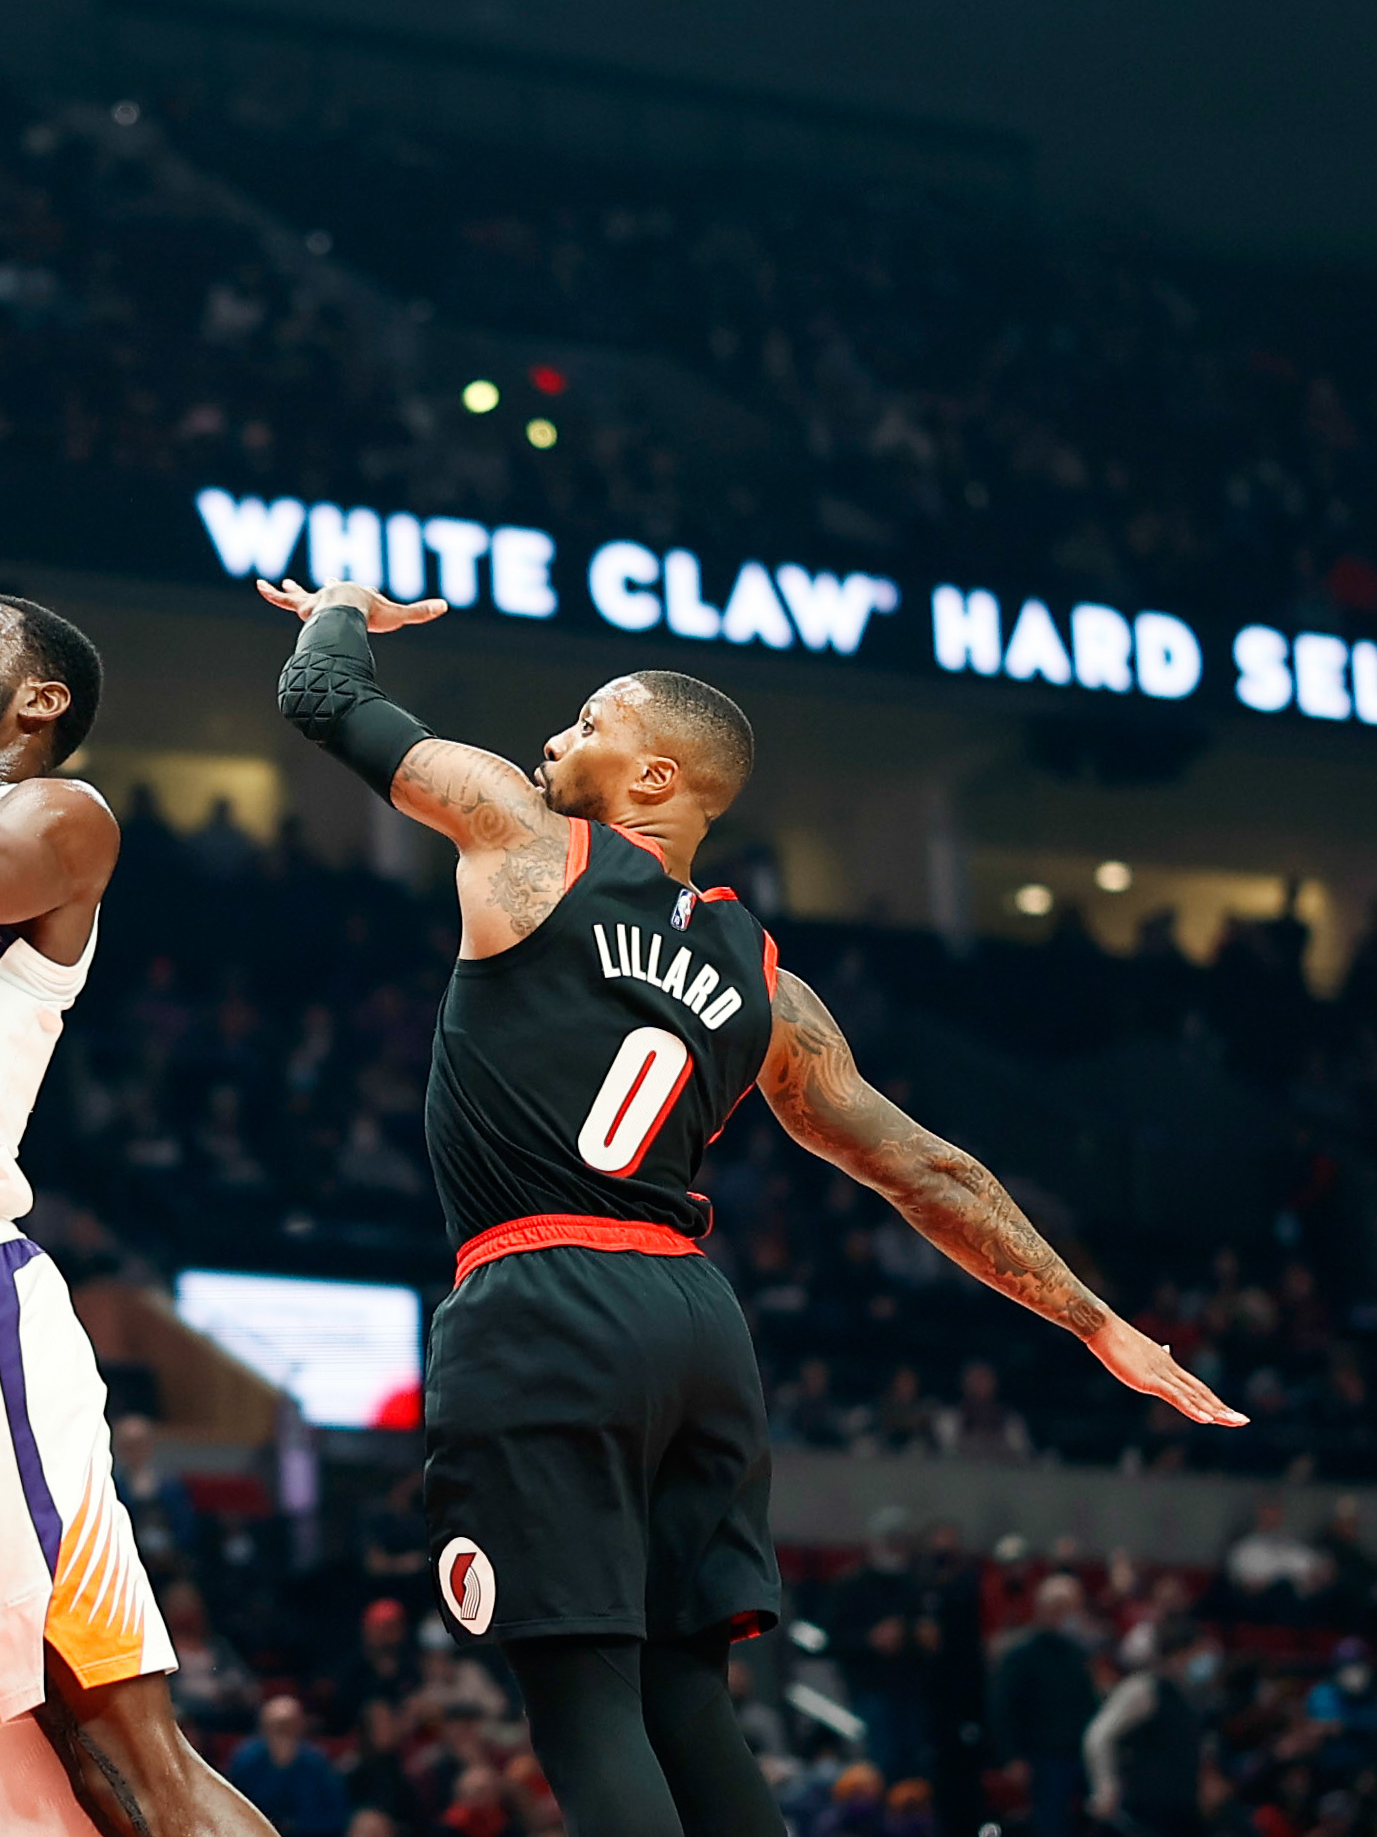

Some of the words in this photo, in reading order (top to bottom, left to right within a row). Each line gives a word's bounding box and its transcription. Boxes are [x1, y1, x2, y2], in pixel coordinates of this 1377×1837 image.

[197, 488, 558, 619] WHITE
[931, 582, 1203, 700] HARD
[593, 923, 743, 1030] LILLARD
[577, 1026, 694, 1178] 0
